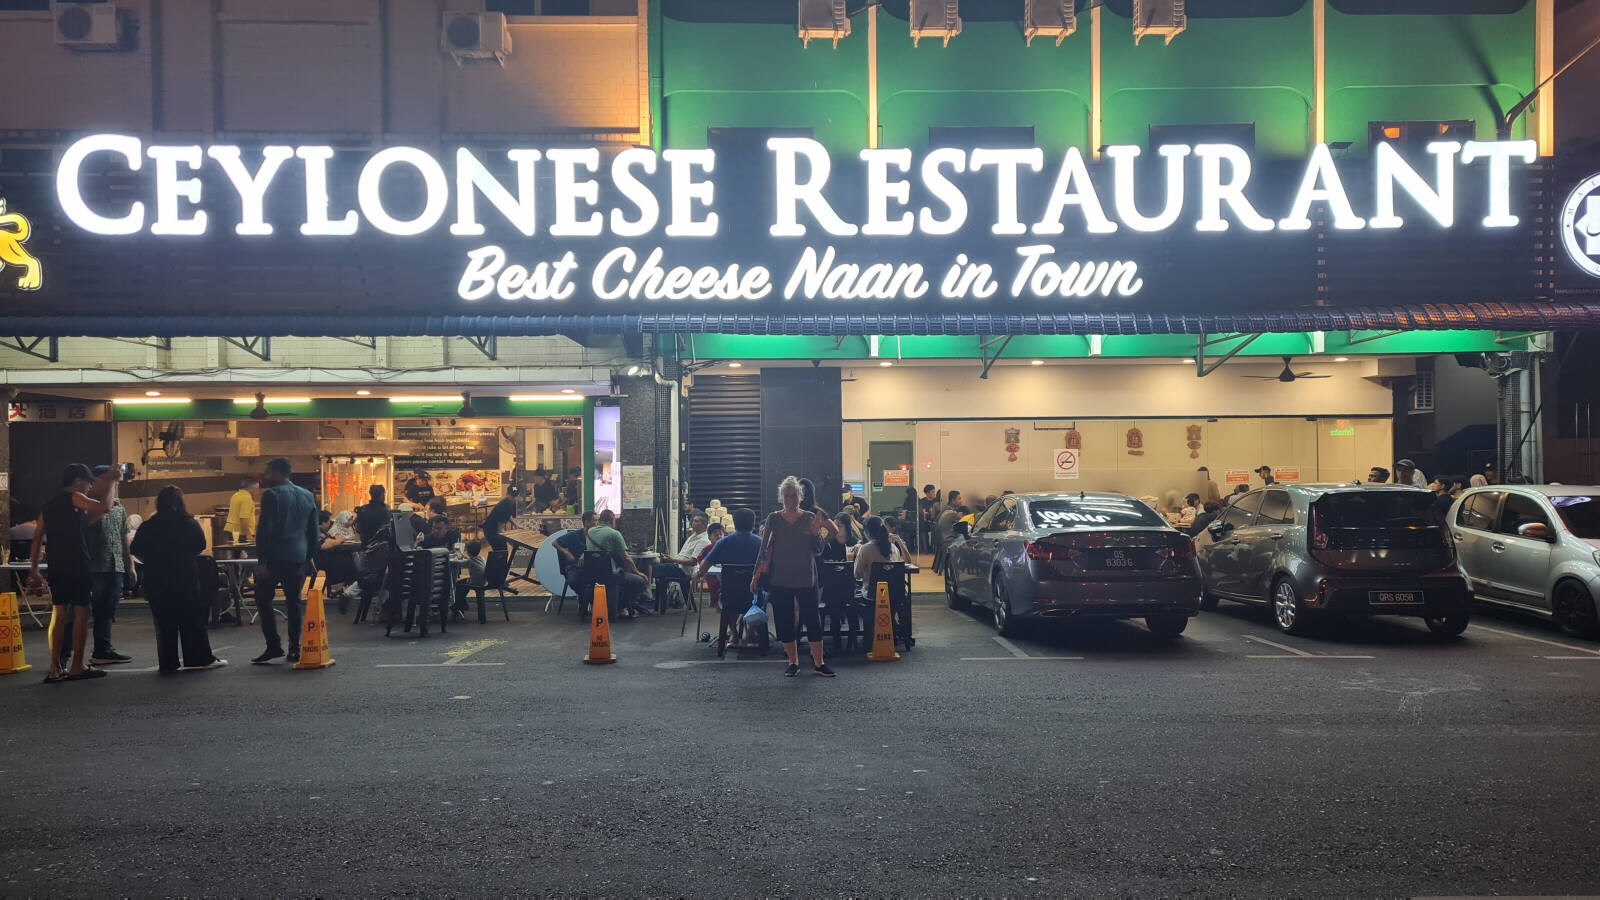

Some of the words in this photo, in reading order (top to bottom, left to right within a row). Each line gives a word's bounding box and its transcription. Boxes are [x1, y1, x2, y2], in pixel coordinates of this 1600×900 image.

[57, 133, 717, 236] CEYLONESE
[767, 136, 1538, 234] RESTAURANT
[458, 246, 578, 300] Best
[592, 246, 772, 300] Cheese
[784, 246, 929, 299] Naan
[941, 253, 998, 298] in
[1012, 244, 1143, 297] Town
[308, 621, 315, 632] P
[596, 617, 604, 628] P
